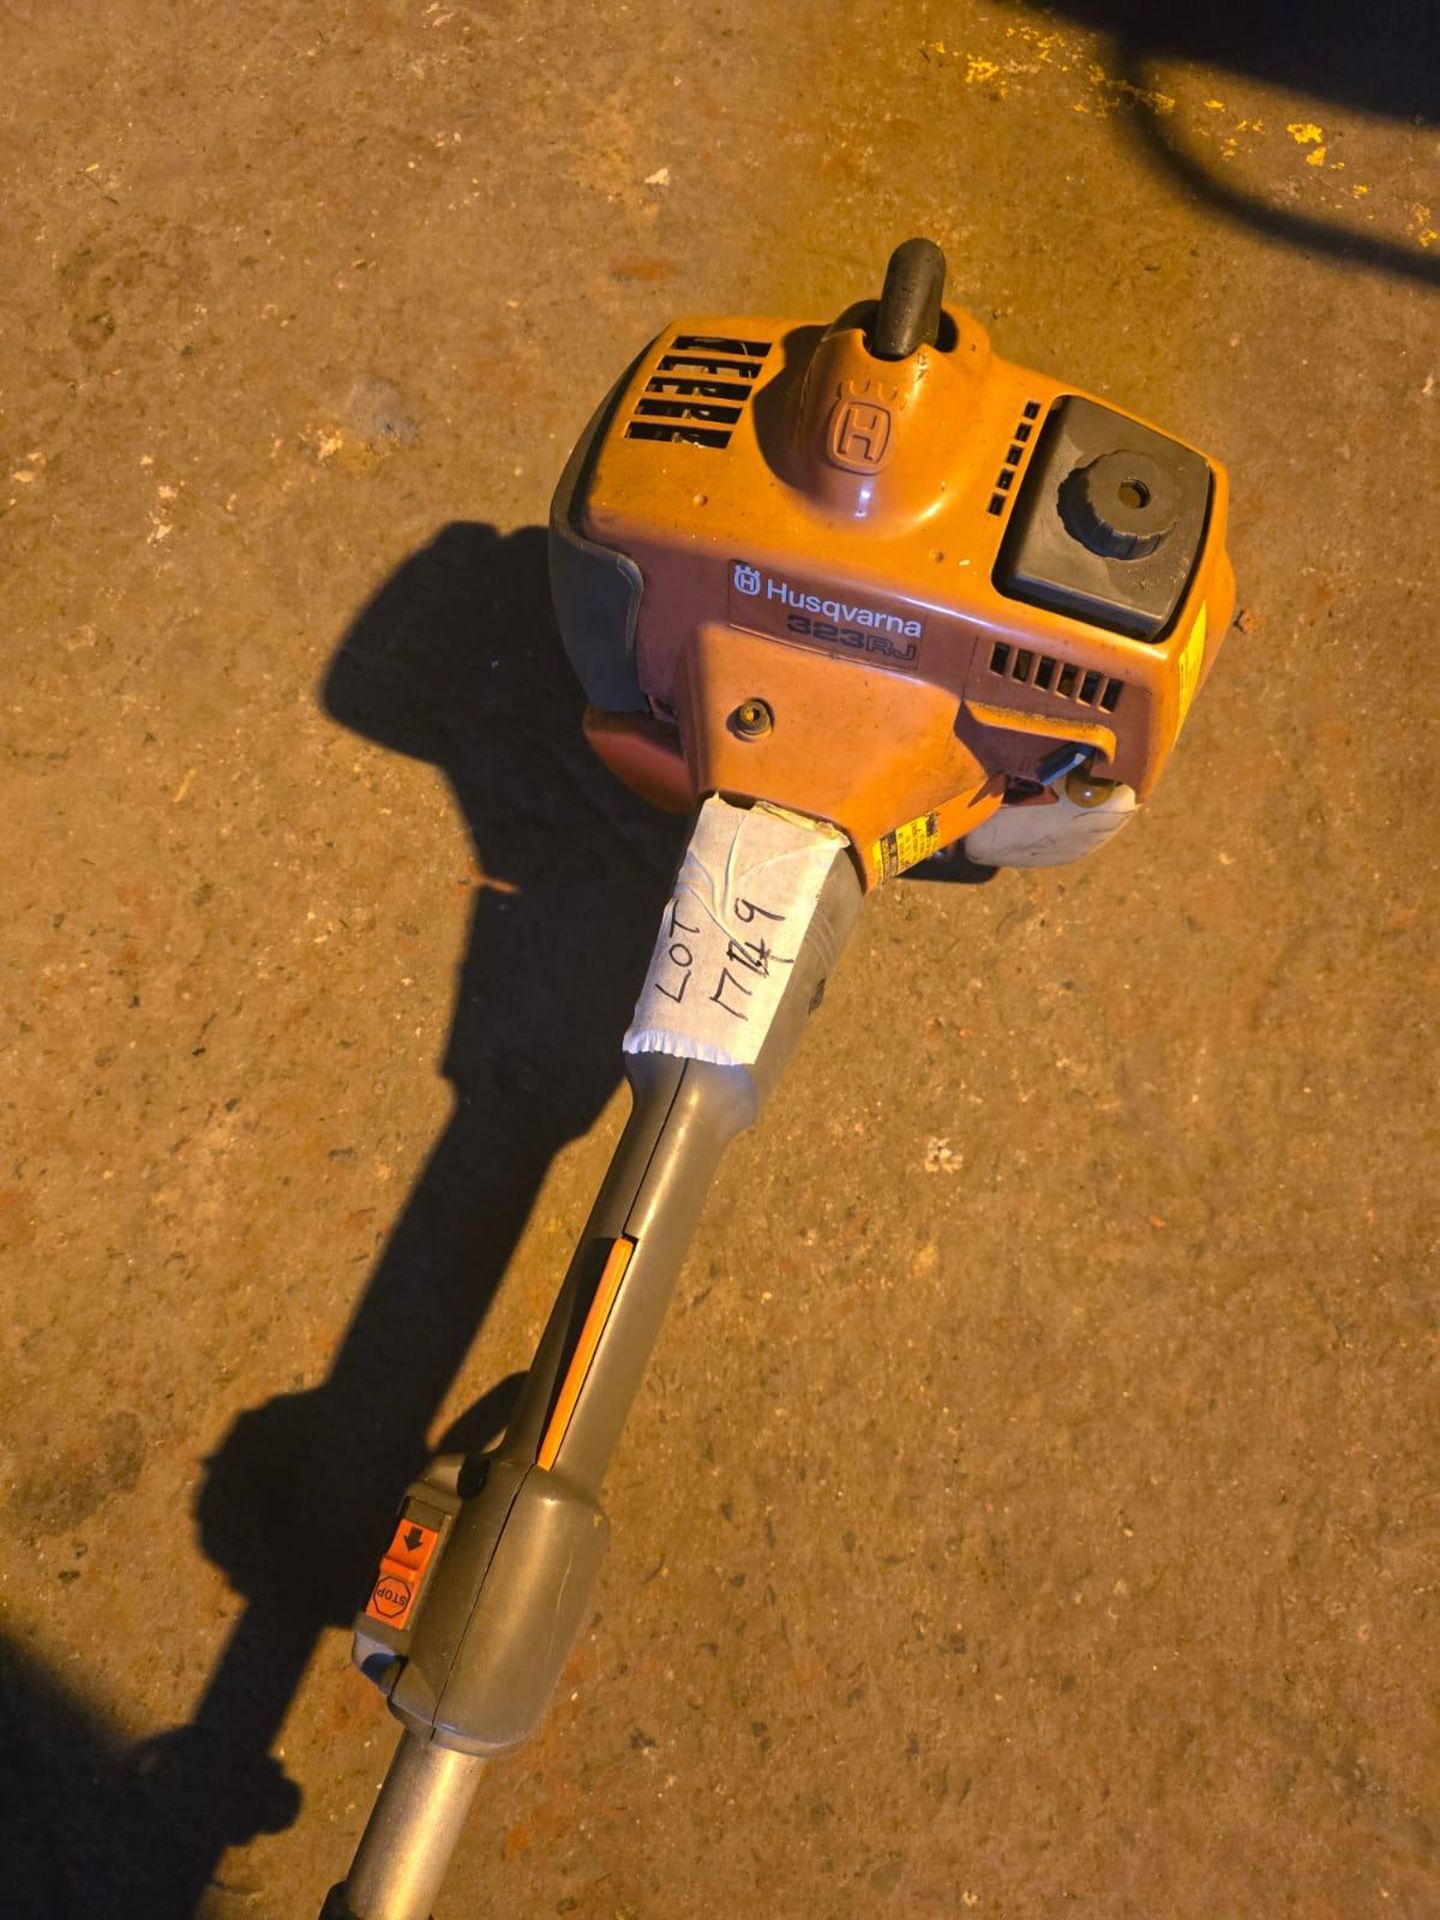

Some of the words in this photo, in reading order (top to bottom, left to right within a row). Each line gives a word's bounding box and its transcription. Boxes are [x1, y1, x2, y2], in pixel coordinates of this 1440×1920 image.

[767, 579, 922, 638] Husqvarna
[787, 614, 917, 661] 323RJ
[655, 899, 700, 1003] LOT
[376, 1588, 407, 1607] STOP
